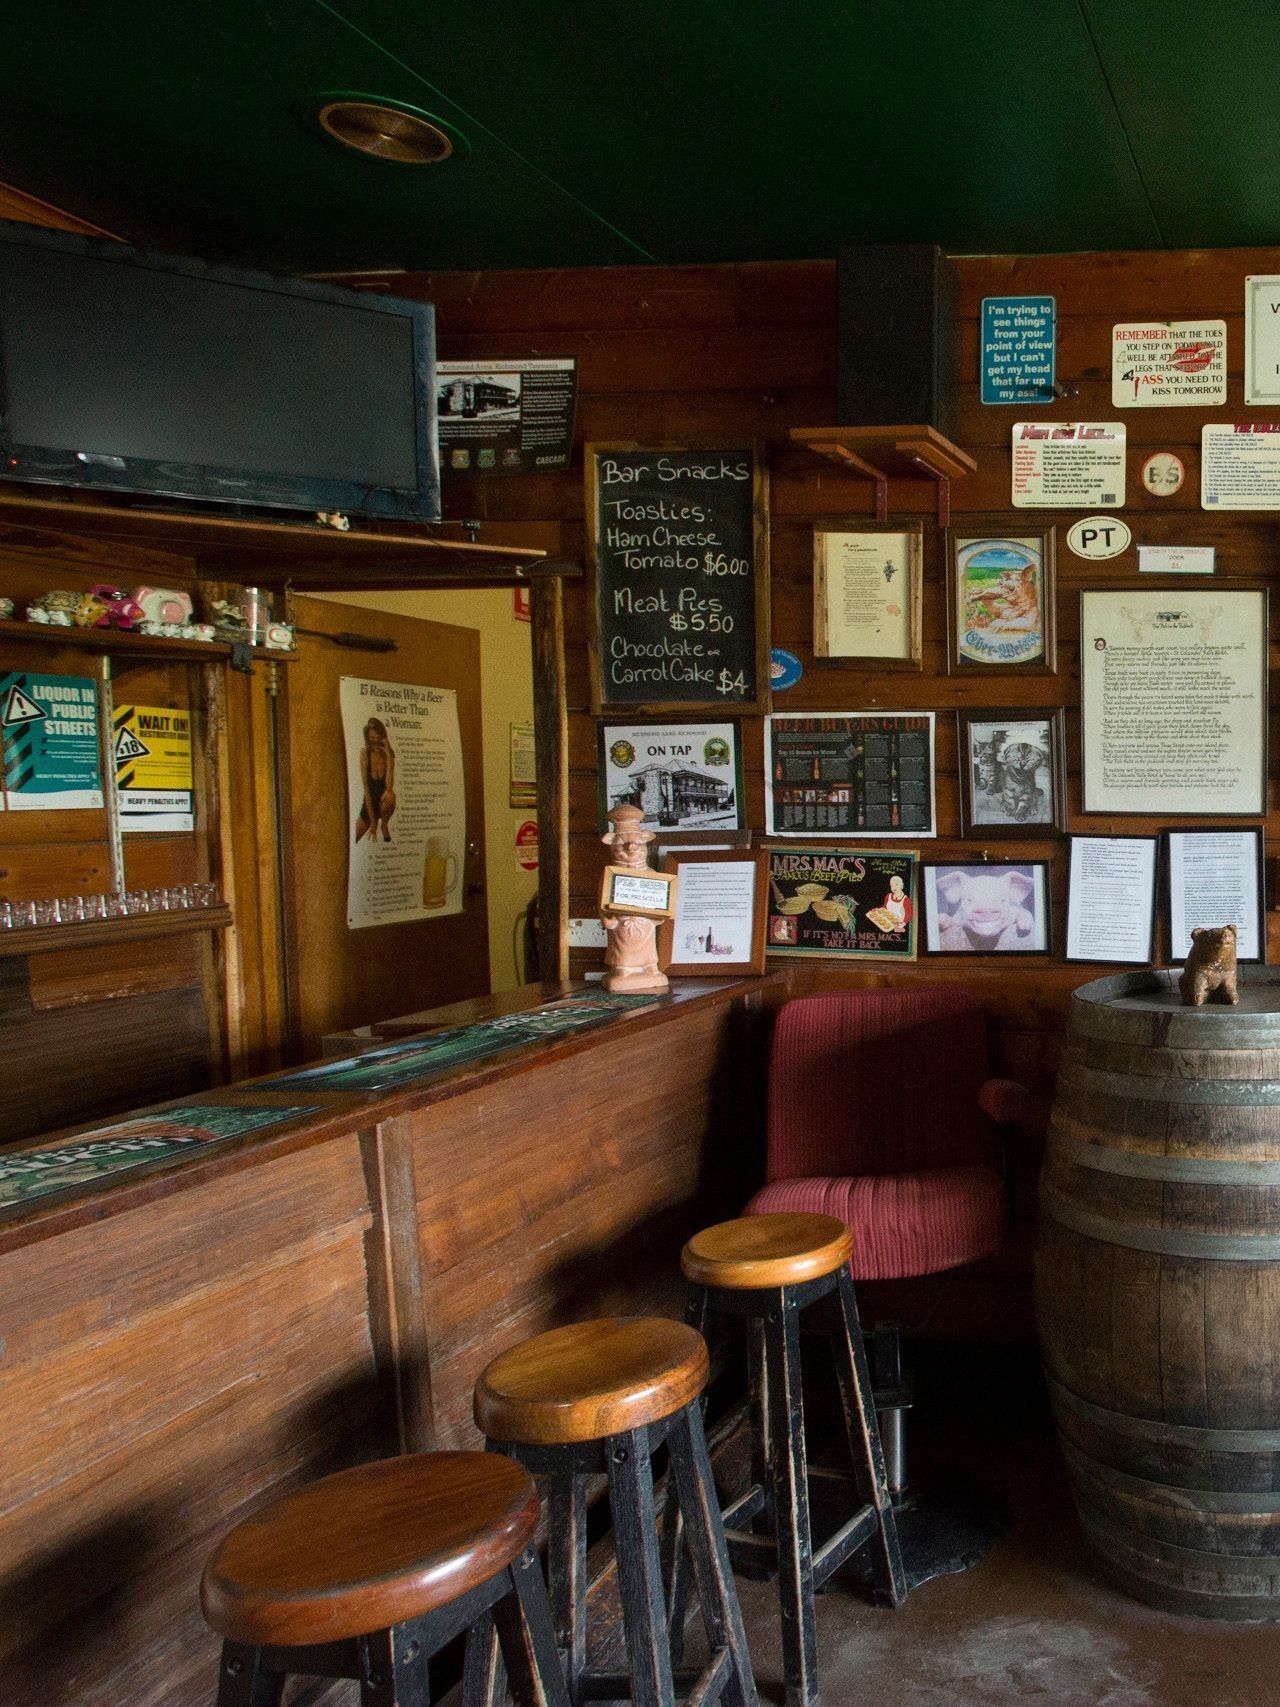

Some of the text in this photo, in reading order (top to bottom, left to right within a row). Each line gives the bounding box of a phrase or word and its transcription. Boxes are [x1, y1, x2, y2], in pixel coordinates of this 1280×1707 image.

[989, 306, 1004, 314] I'm
[1008, 305, 1037, 316] trying
[1014, 317, 1046, 327] things
[994, 329, 1045, 339] from your
[1116, 330, 1167, 340] REMEMBER
[986, 341, 1052, 352] point of view
[994, 352, 1044, 362] but I can't
[988, 364, 1050, 376] get my head
[992, 377, 1012, 386] that
[1015, 377, 1029, 385] far
[1142, 375, 1164, 384] ASS
[1165, 376, 1183, 384] YOU
[1000, 391, 1014, 399] my
[1174, 386, 1222, 394] TOMORROW
[536, 454, 566, 465] CASCADE
[602, 459, 749, 484] Bar Snacks
[604, 500, 713, 522] Toasties:
[608, 526, 722, 547] Ham Cheese
[1081, 527, 1116, 548] PT
[614, 549, 749, 576] Tomato $6.00
[614, 587, 723, 614] Meat Pies
[611, 636, 704, 659] Chocolate
[612, 658, 715, 684] Carrot Cake
[716, 667, 749, 695] $4
[32, 685, 95, 702] LIQUOR IN
[360, 684, 368, 695] 15
[370, 684, 402, 699] Reasons
[403, 688, 420, 704] Why
[427, 691, 443, 703] Beer
[51, 704, 95, 719] PUBLIC
[376, 701, 428, 715] is Better Than
[45, 720, 96, 736] STREETS
[138, 715, 171, 730] WAIT
[385, 719, 390, 727] a
[647, 745, 692, 756] ON TAP
[773, 855, 812, 872] MRS.
[813, 856, 866, 879] MAC'S
[824, 940, 841, 948] TAKE
[860, 941, 880, 949] BACK
